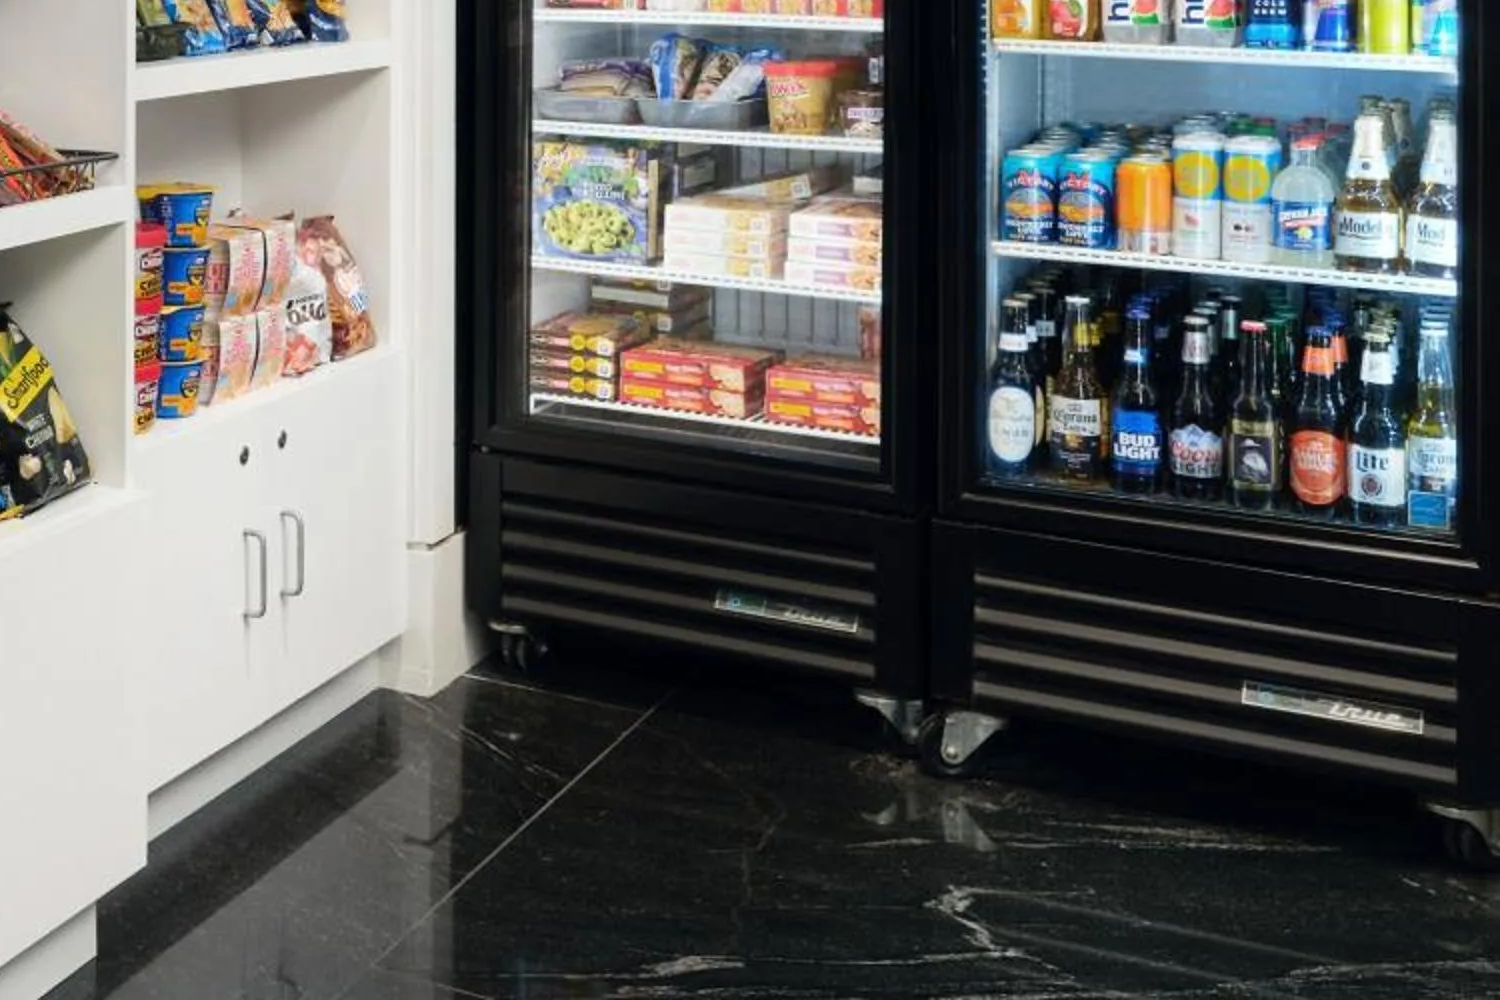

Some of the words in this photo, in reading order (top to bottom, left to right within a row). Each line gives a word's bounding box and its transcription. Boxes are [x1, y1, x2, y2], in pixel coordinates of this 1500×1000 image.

[1118, 431, 1156, 447] BUD
[1113, 445, 1162, 461] LIGHT
[1355, 450, 1389, 473] Lite
